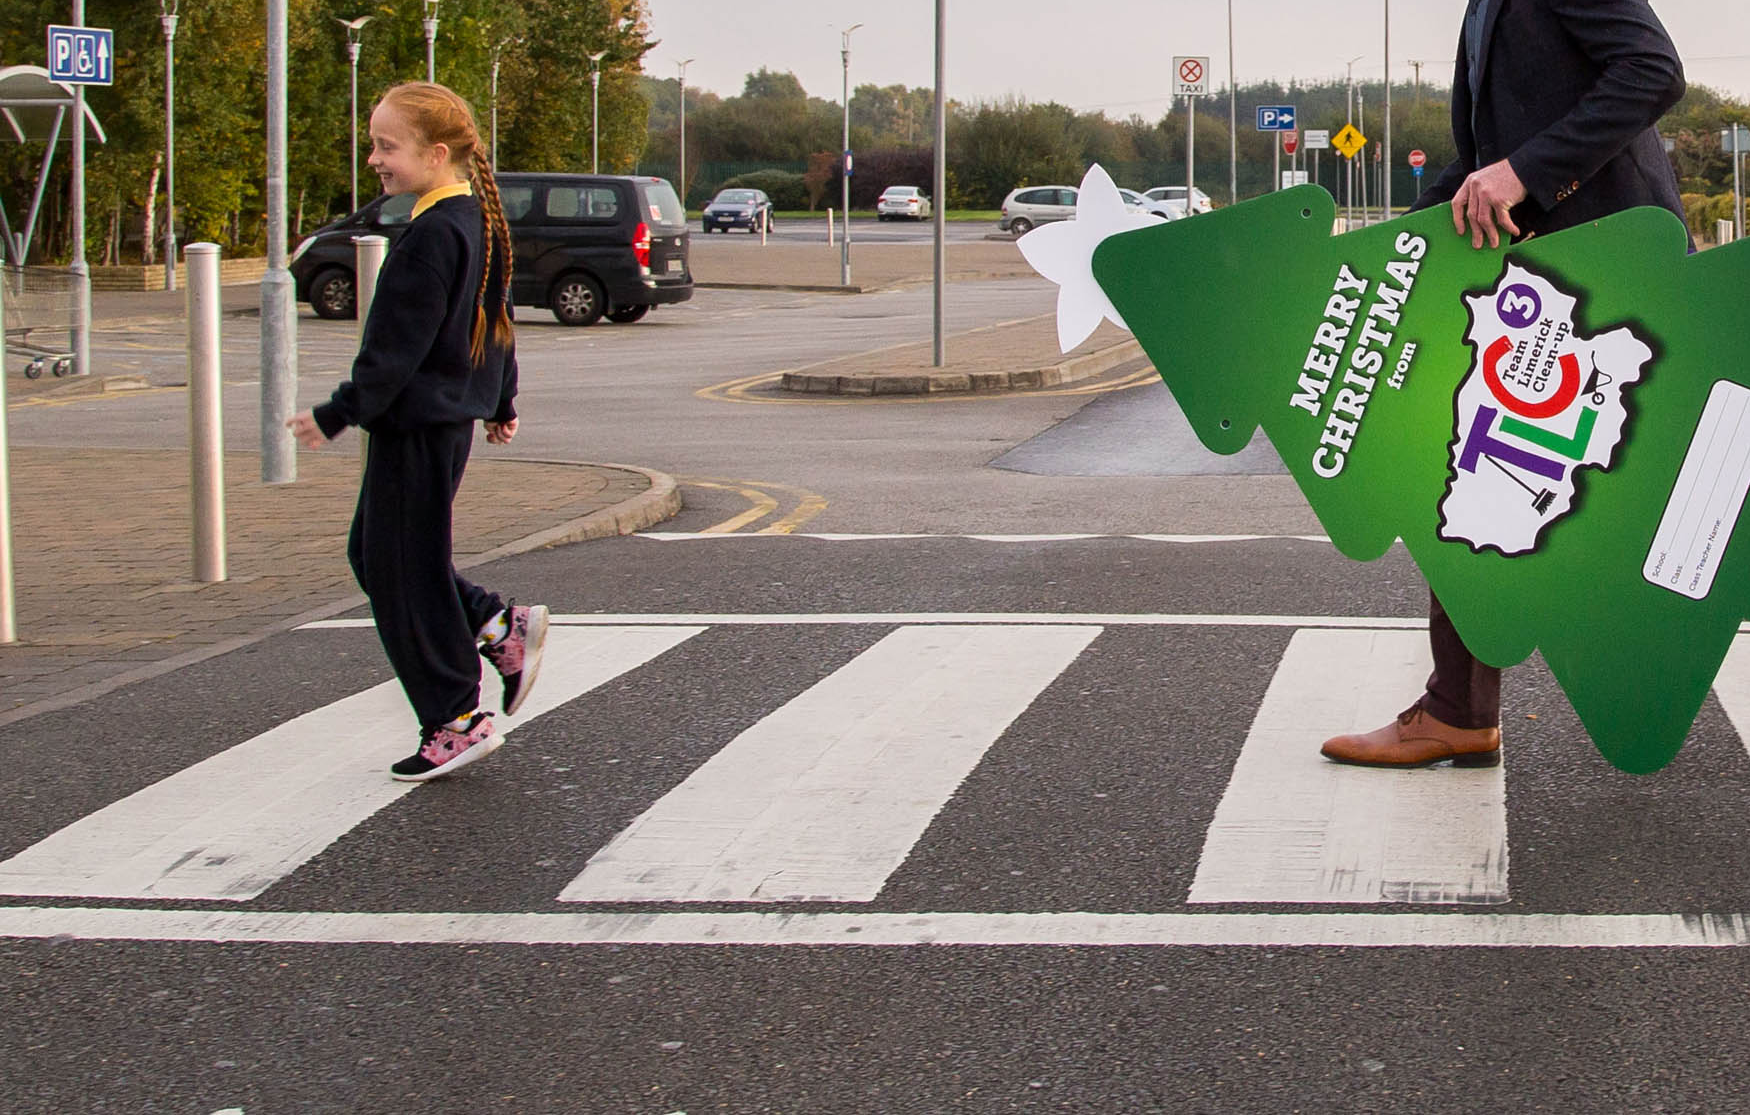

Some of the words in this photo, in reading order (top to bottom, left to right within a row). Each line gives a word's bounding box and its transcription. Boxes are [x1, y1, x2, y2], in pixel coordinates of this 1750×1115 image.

[56, 39, 70, 70] P
[1179, 85, 1204, 93] TAXI
[1263, 111, 1276, 125] P
[1501, 290, 1536, 321] 3
[1289, 264, 1369, 417] MERRY
[1312, 232, 1427, 479] CHRISTMAS
[1502, 339, 1529, 381] Team
[1517, 317, 1554, 389] Limerick
[1532, 321, 1571, 393] Clean-up
[1386, 341, 1417, 390] from
[1688, 571, 1702, 592] Class
[1696, 543, 1713, 571] Teacher
